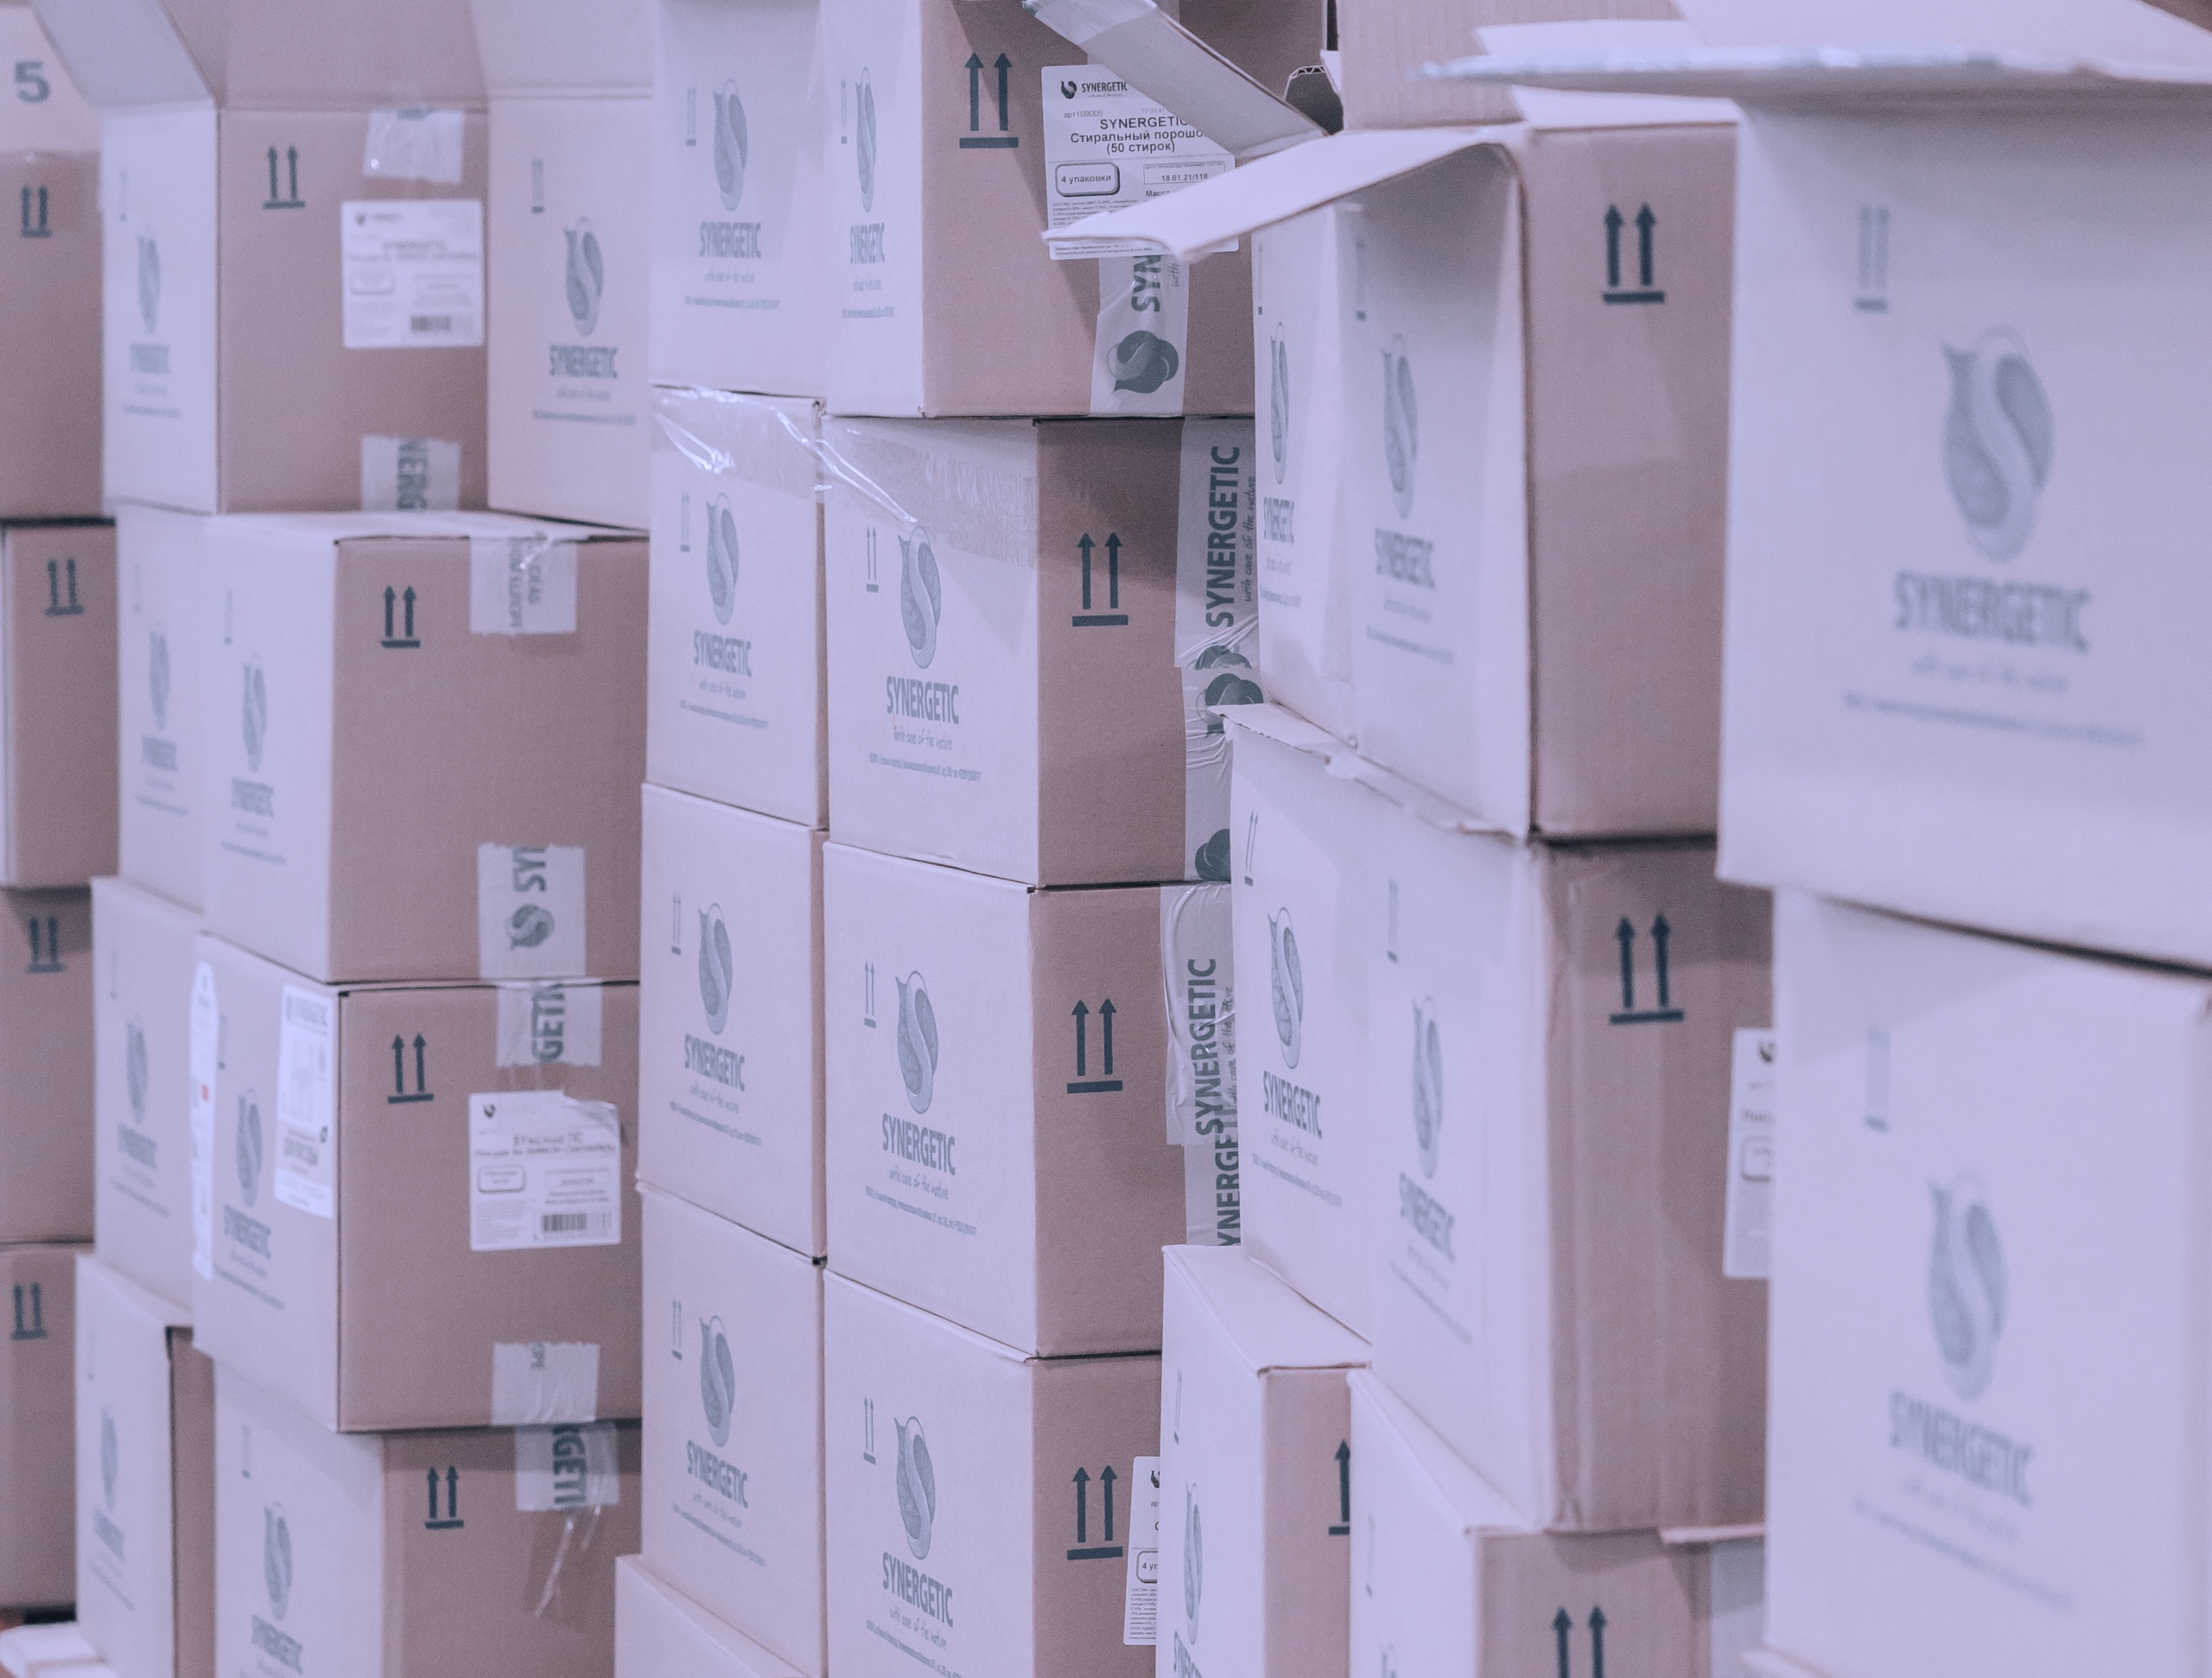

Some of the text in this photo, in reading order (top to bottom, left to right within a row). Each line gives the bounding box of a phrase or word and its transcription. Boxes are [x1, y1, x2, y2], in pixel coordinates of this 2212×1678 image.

[15, 60, 51, 103] 5
[1081, 81, 1128, 93] SYNERGETIC
[1071, 130, 1206, 145] Стиральный порошо
[1106, 140, 1175, 156] (50 стирок)
[1069, 175, 1112, 185] упаковки
[1205, 445, 1240, 627] SYNERGETIC
[887, 675, 960, 725] SYNERGETIC
[1187, 958, 1224, 1136] SYNERGETIC
[1263, 1070, 1323, 1140] SYNERGETIC
[882, 1111, 957, 1176] SYNERGETIC
[882, 1551, 954, 1628] SYNERGETIC
